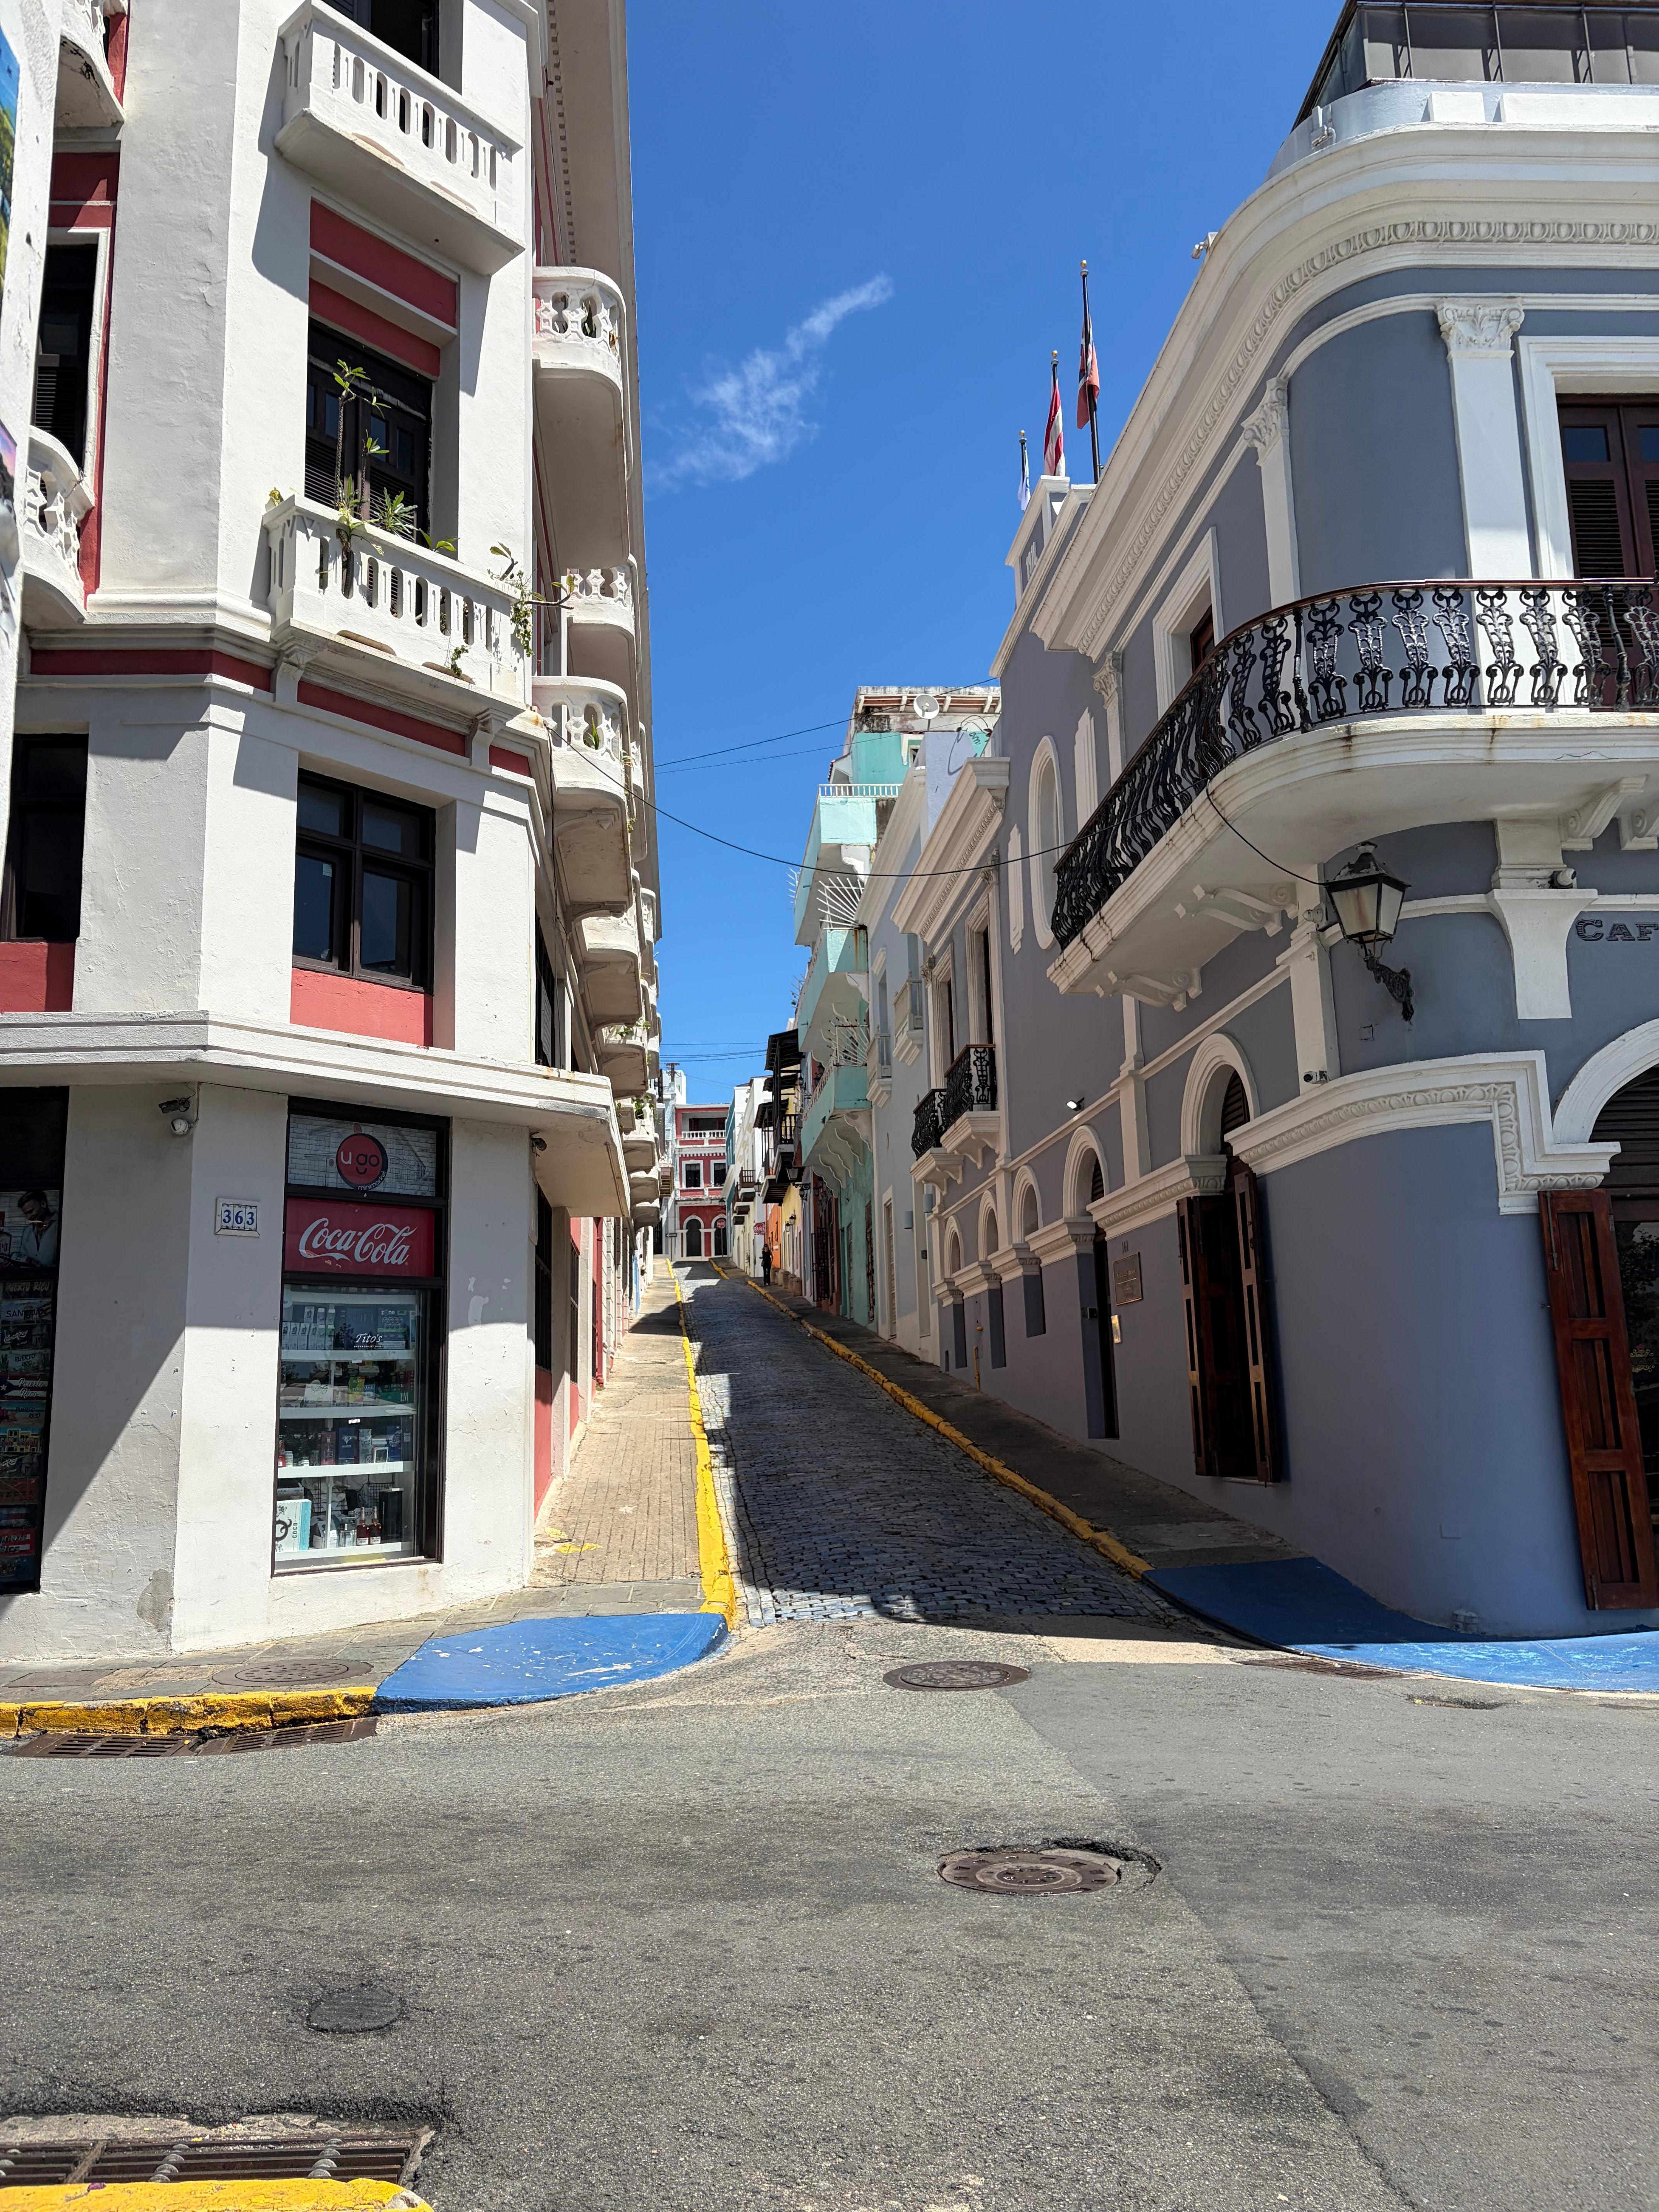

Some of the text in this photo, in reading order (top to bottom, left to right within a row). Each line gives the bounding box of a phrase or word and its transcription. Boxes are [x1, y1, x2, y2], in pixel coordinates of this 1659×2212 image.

[341, 1151, 352, 1164] u
[223, 1209, 254, 1225] 363
[298, 1218, 417, 1265] Coca-Cola
[356, 1333, 383, 1343] Tito's
[15, 1353, 35, 1362] PUERTO
